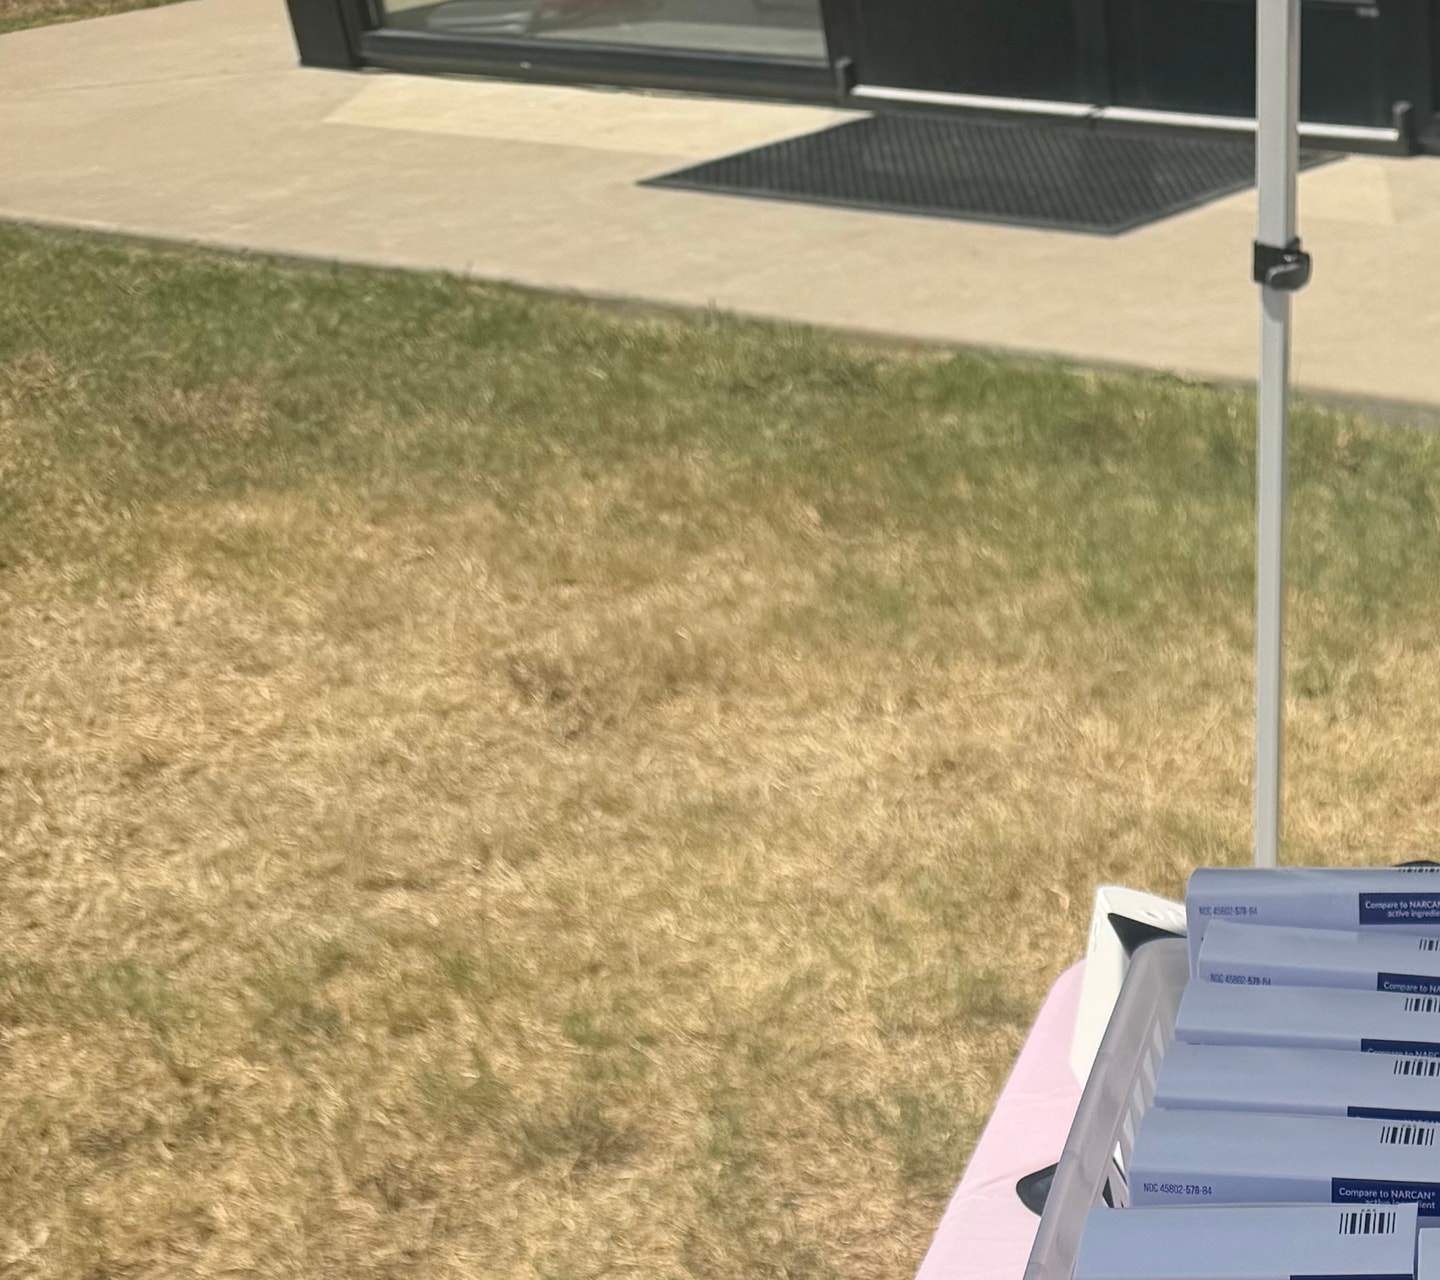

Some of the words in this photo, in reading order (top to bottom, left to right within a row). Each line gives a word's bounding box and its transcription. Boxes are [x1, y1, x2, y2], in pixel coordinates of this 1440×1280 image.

[1365, 901, 1397, 910] Compare
[1400, 901, 1408, 909] to
[1387, 909, 1410, 918] active
[1144, 1183, 1159, 1193] NDC
[1339, 1187, 1378, 1200] Compare
[1380, 1190, 1389, 1198] to
